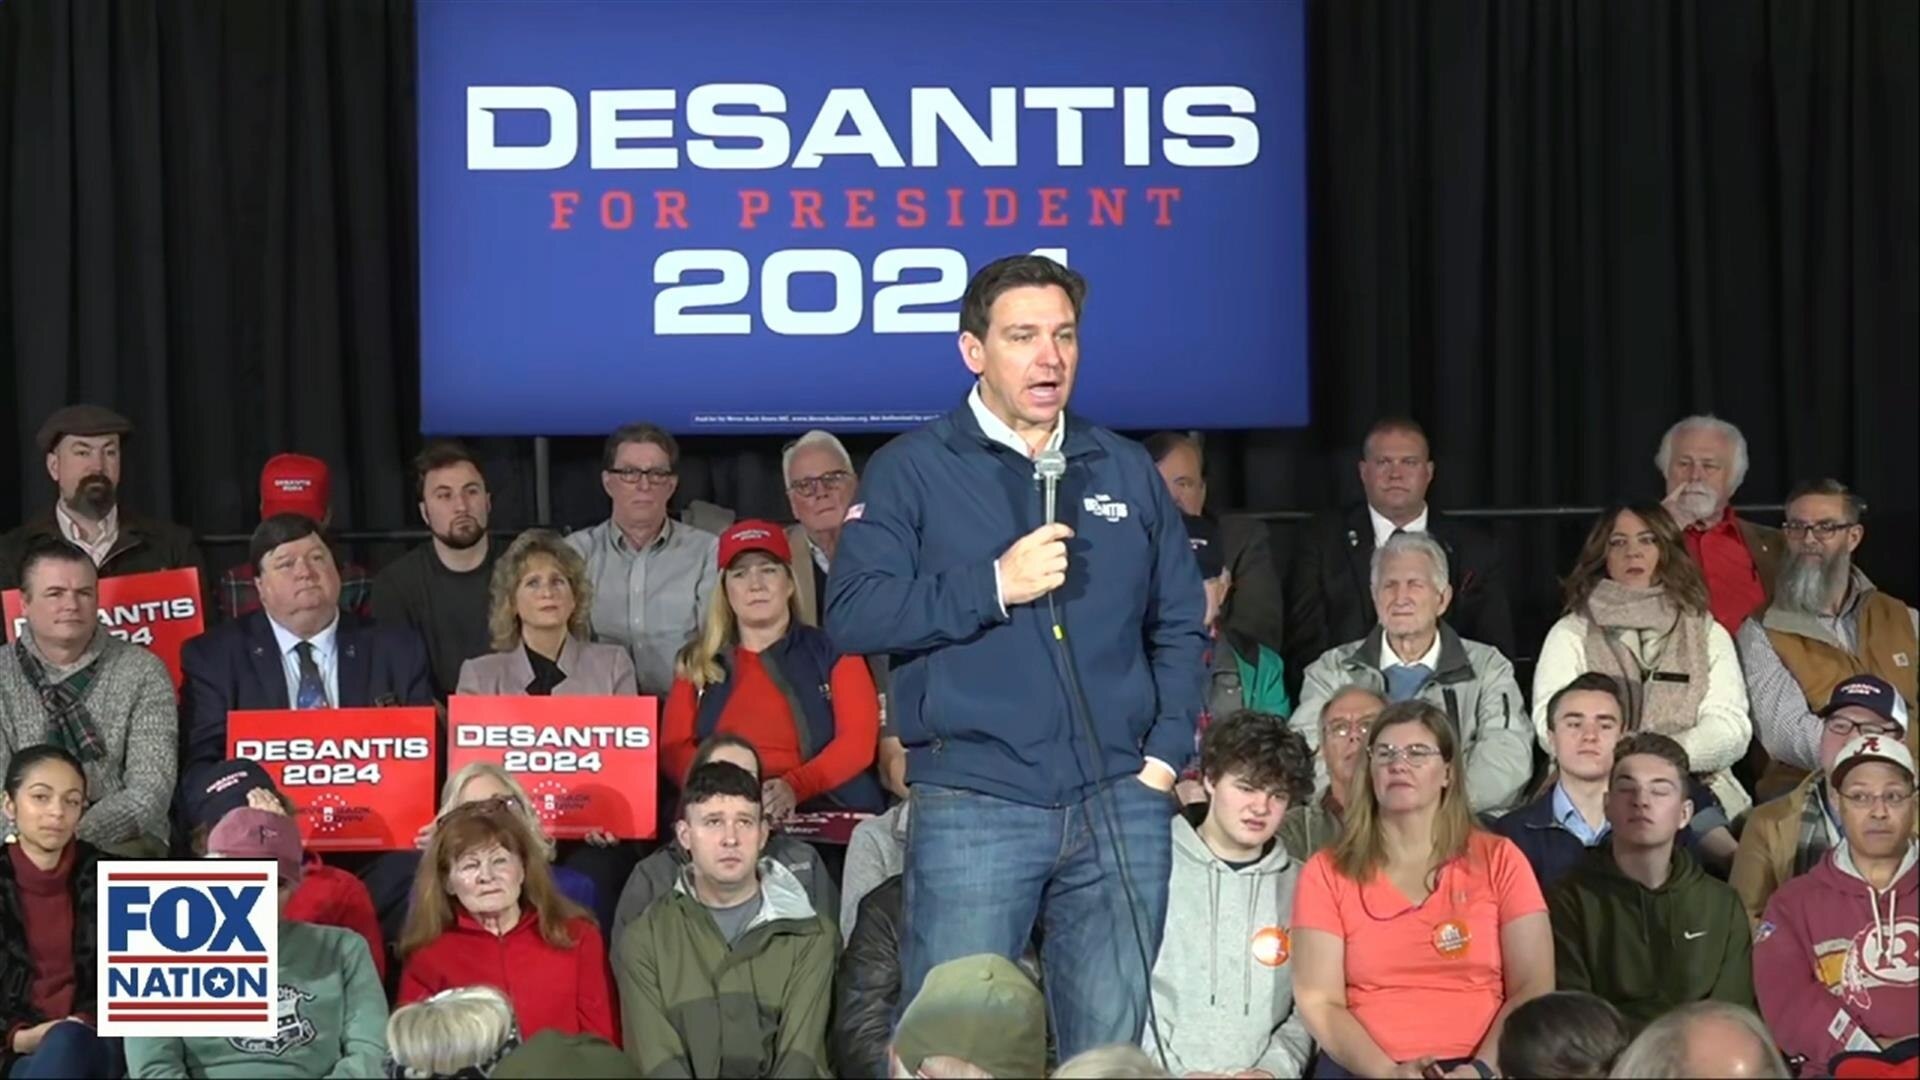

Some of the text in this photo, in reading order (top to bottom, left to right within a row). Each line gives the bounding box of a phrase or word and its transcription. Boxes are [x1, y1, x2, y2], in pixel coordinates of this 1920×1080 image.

[553, 189, 1179, 229] FOR PRESIDENT
[654, 249, 1069, 334] 202
[14, 597, 196, 638] DANTIS
[236, 736, 429, 761] DESANTIS
[457, 725, 651, 748] DESANTIS
[282, 763, 381, 785] 2024
[504, 751, 602, 773] 2024
